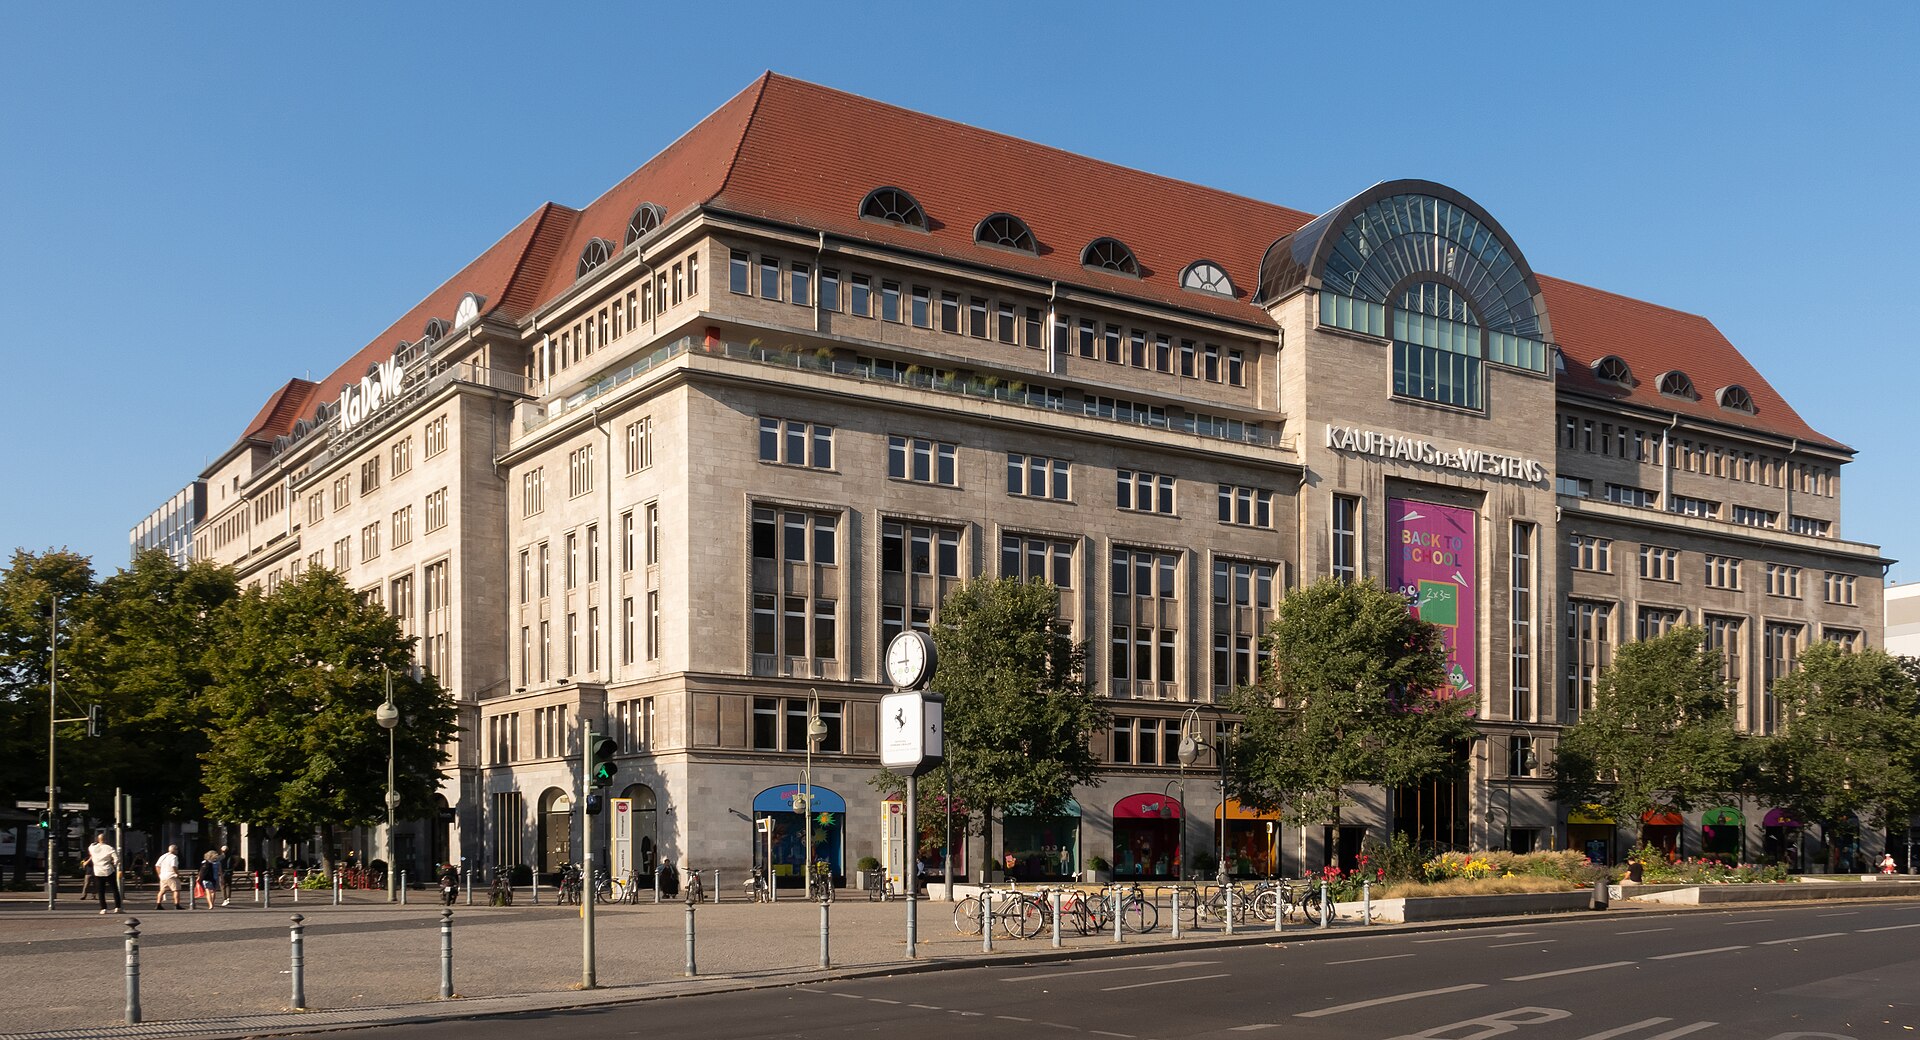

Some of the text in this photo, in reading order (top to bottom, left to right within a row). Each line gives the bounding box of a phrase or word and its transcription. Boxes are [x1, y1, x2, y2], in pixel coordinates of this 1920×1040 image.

[341, 354, 404, 433] KaDeWe
[1326, 423, 1542, 482] KAUFHAUS DES WESTENS
[1401, 529, 1463, 551] BACK TO
[1402, 546, 1462, 567] SCHOOL
